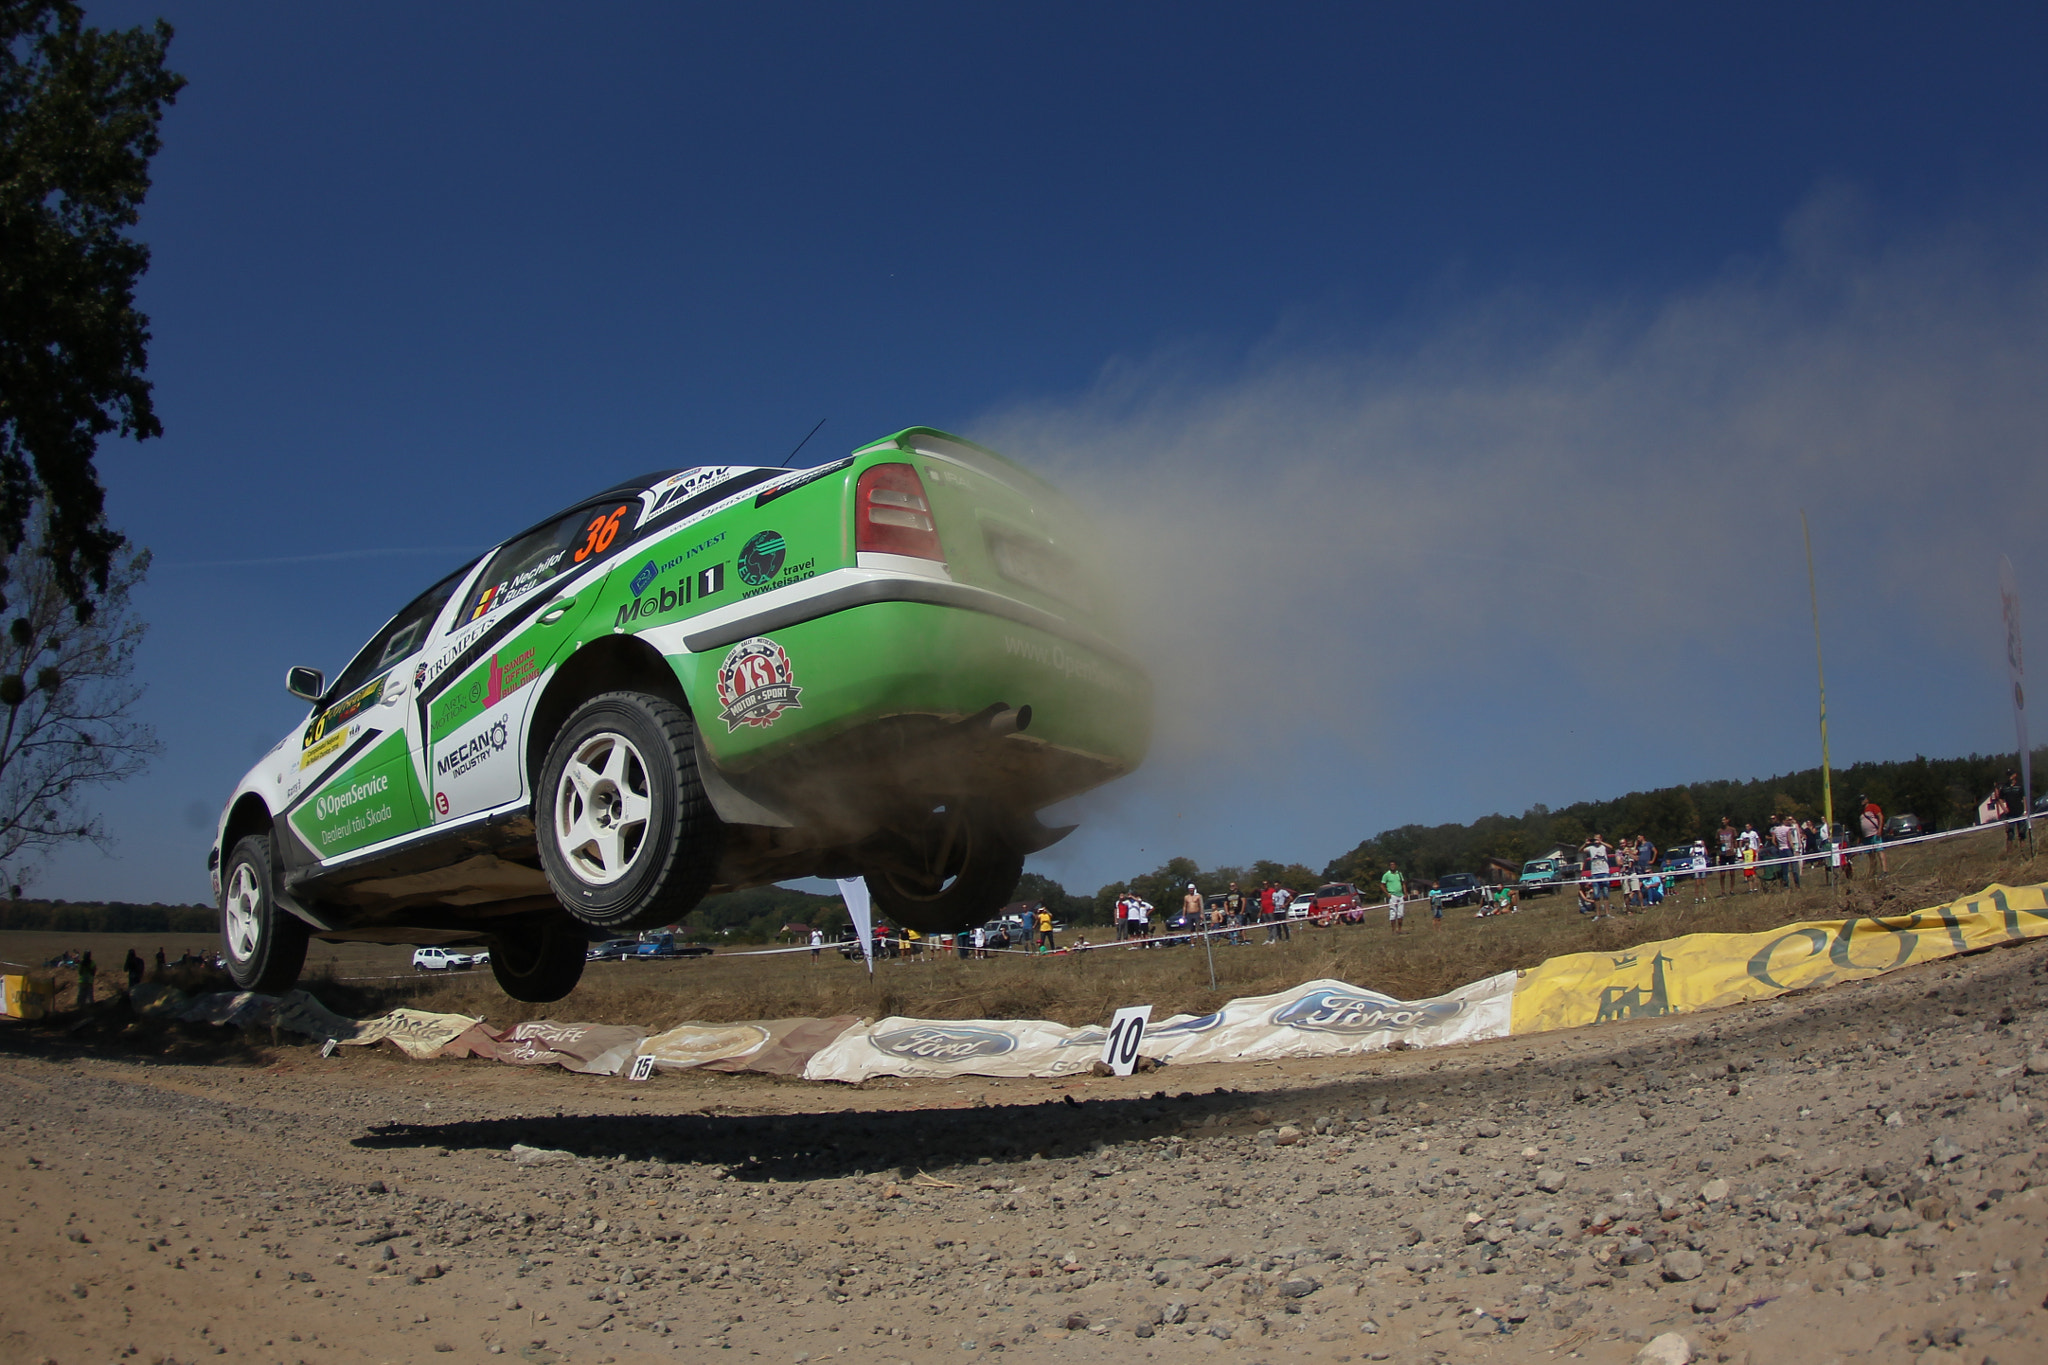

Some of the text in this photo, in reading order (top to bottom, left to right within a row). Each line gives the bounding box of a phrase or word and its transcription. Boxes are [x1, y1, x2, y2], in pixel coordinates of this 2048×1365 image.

[573, 504, 627, 563] 36
[661, 531, 727, 573] PRO INVEST
[783, 557, 815, 576] travel
[496, 550, 566, 597] R. Nechifor
[738, 557, 771, 586] TEISA
[742, 570, 815, 599] www.teisa.ro
[487, 579, 537, 613] A. Rusu
[613, 575, 692, 627] Mobil
[427, 617, 496, 681] TRUMPETS
[503, 646, 536, 674] SANDRU
[501, 668, 539, 698] BUILDING
[505, 659, 535, 684] OFFICE
[740, 657, 769, 692] XS
[430, 701, 467, 731] MOTION
[442, 693, 462, 715] ART
[730, 687, 788, 716] MOTOR SPORT
[452, 748, 492, 779] INDUSTRY
[327, 775, 388, 815] OpenService
[321, 820, 350, 845] Dealerul
[367, 804, 392, 829] Škoda
[1305, 994, 1426, 1028] Ford
[892, 1028, 991, 1058] Ford
[1107, 1016, 1144, 1064] 10
[635, 1057, 652, 1078] 15
